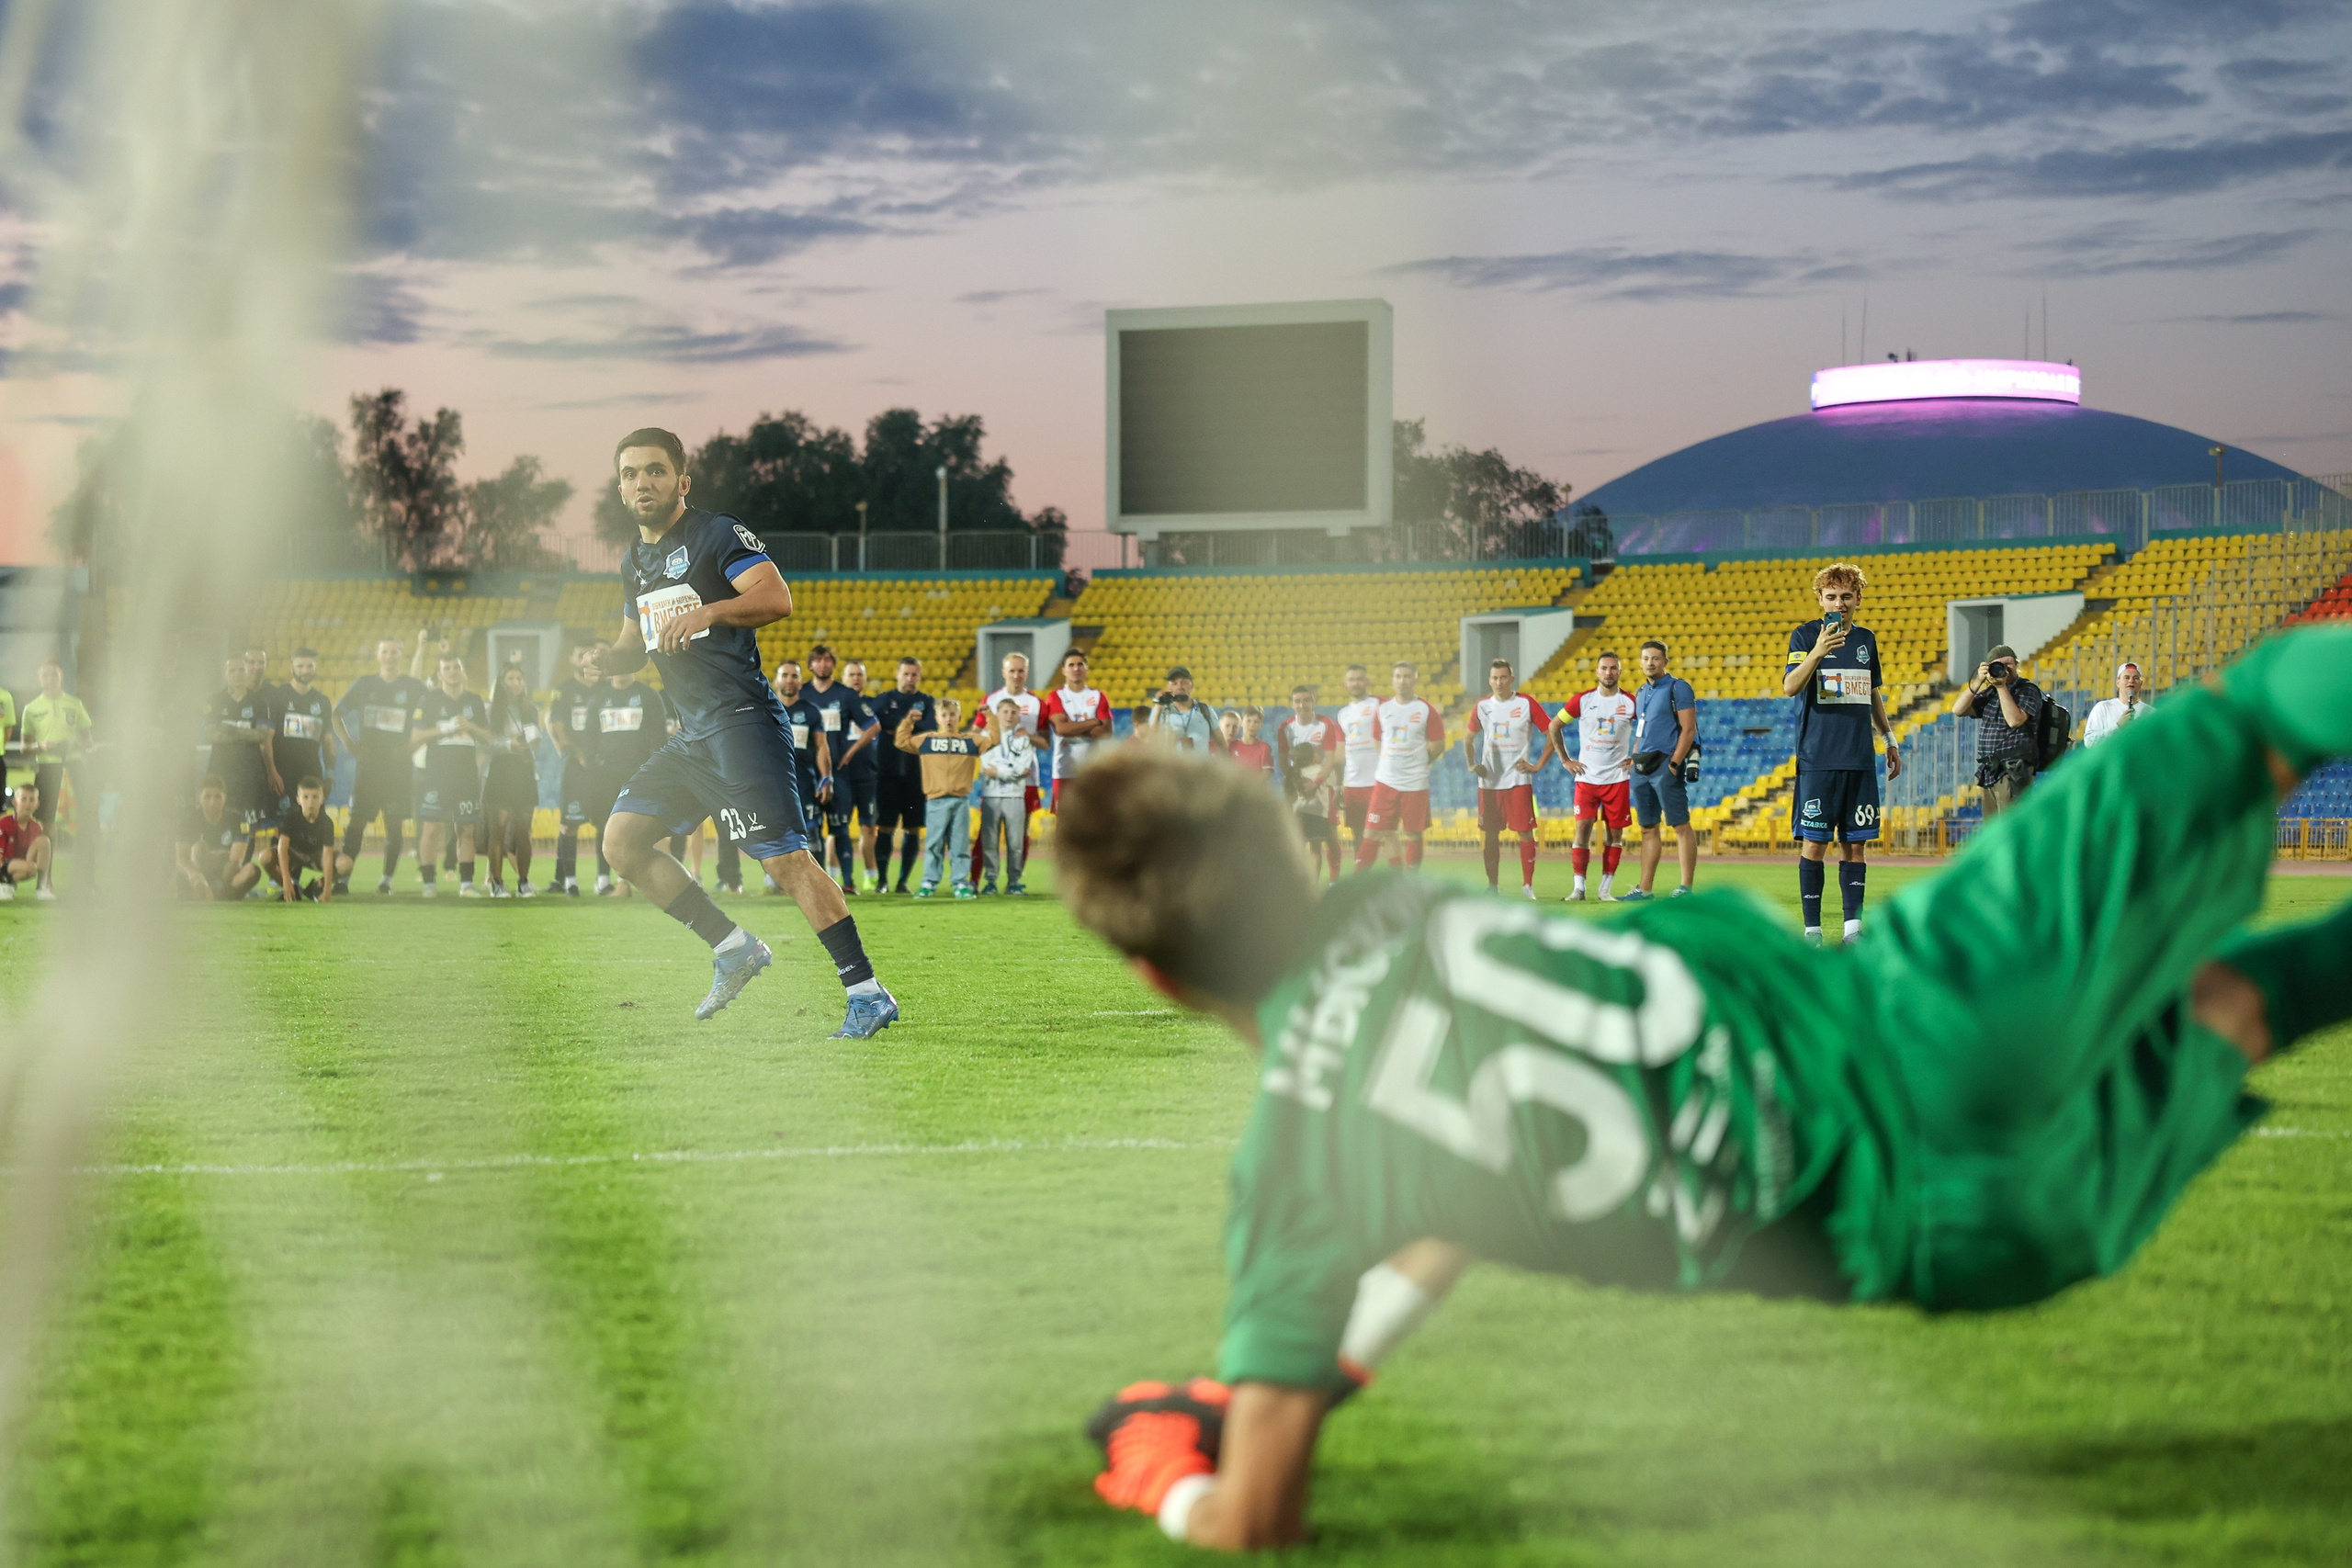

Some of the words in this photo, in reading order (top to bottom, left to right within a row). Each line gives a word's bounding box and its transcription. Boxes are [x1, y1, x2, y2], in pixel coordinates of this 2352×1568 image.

[720, 807, 747, 841] 23
[1854, 804, 1875, 827] 69
[1363, 898, 1705, 1223] 50
